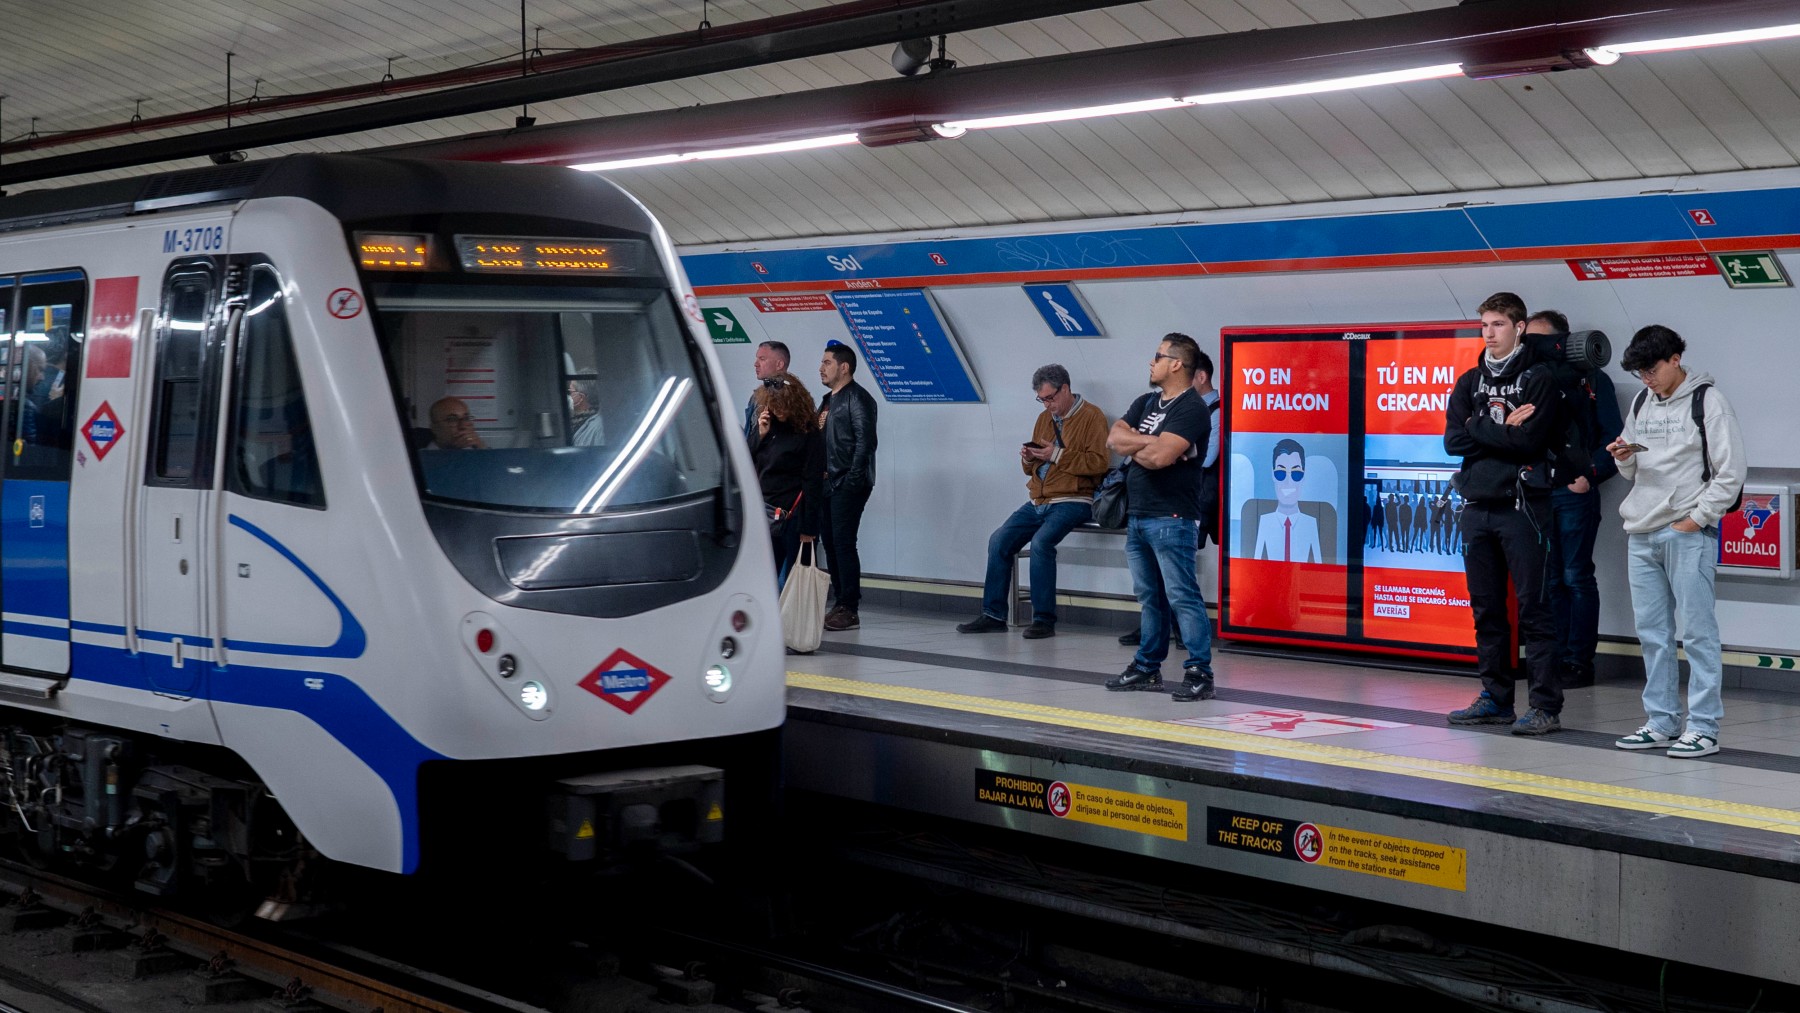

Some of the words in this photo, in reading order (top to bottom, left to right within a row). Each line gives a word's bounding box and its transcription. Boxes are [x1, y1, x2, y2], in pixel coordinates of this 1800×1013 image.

[1695, 211, 1710, 224] 2
[163, 226, 223, 253] M-3708
[755, 263, 766, 273] 2
[826, 254, 863, 272] Sol
[932, 254, 944, 264] 2
[844, 281, 873, 290] Andén
[1242, 367, 1266, 385] YO
[1270, 367, 1291, 385] EN
[1376, 361, 1399, 385] TÚ
[1403, 366, 1429, 385] EN
[1432, 366, 1455, 385] MI
[1242, 393, 1262, 411] MI
[1266, 393, 1329, 411] FALCON
[1376, 388, 1451, 412] CERCANÍ
[1724, 538, 1777, 556] CUÍDALO
[1382, 586, 1410, 594] LLAMABA
[1412, 587, 1445, 596] CERCANÍAS
[1374, 594, 1394, 602] HASTA
[1417, 596, 1447, 605] ENCARGÓ
[1448, 597, 1470, 607] SÁNCH
[1376, 605, 1407, 615] AVERÍAS
[602, 674, 647, 689] Metro
[995, 776, 1044, 794] PROHIBIDO
[979, 789, 1007, 803] BAJAR
[1008, 793, 1015, 804] A
[1016, 795, 1028, 806] LA
[1029, 795, 1044, 810] VÍA
[1076, 791, 1085, 800] En
[1086, 794, 1104, 803] caso
[1105, 795, 1114, 805] de
[1136, 801, 1145, 811] de
[1146, 802, 1175, 817] objetos,
[1076, 804, 1101, 816] diríjase
[1102, 808, 1109, 816] al
[1110, 810, 1140, 823] personal
[1142, 814, 1151, 824] de
[1152, 816, 1184, 831] estación
[1232, 816, 1260, 831] KEEP
[1262, 820, 1283, 835] OFF
[1218, 830, 1237, 845] THE
[1241, 834, 1283, 852] TRACKS
[1329, 832, 1336, 840] In
[1337, 833, 1350, 843] the
[1351, 836, 1372, 847] event
[1374, 838, 1382, 848] of
[1383, 840, 1410, 853] objects
[1412, 845, 1445, 860] dropped
[1328, 845, 1338, 853] on
[1340, 845, 1352, 856] the
[1353, 848, 1378, 861] tracks,
[1380, 852, 1398, 864] seek
[1399, 855, 1441, 871] assistance
[1328, 856, 1346, 866] from
[1347, 859, 1360, 869] the
[1361, 861, 1387, 874] station
[1388, 866, 1407, 878] staff
